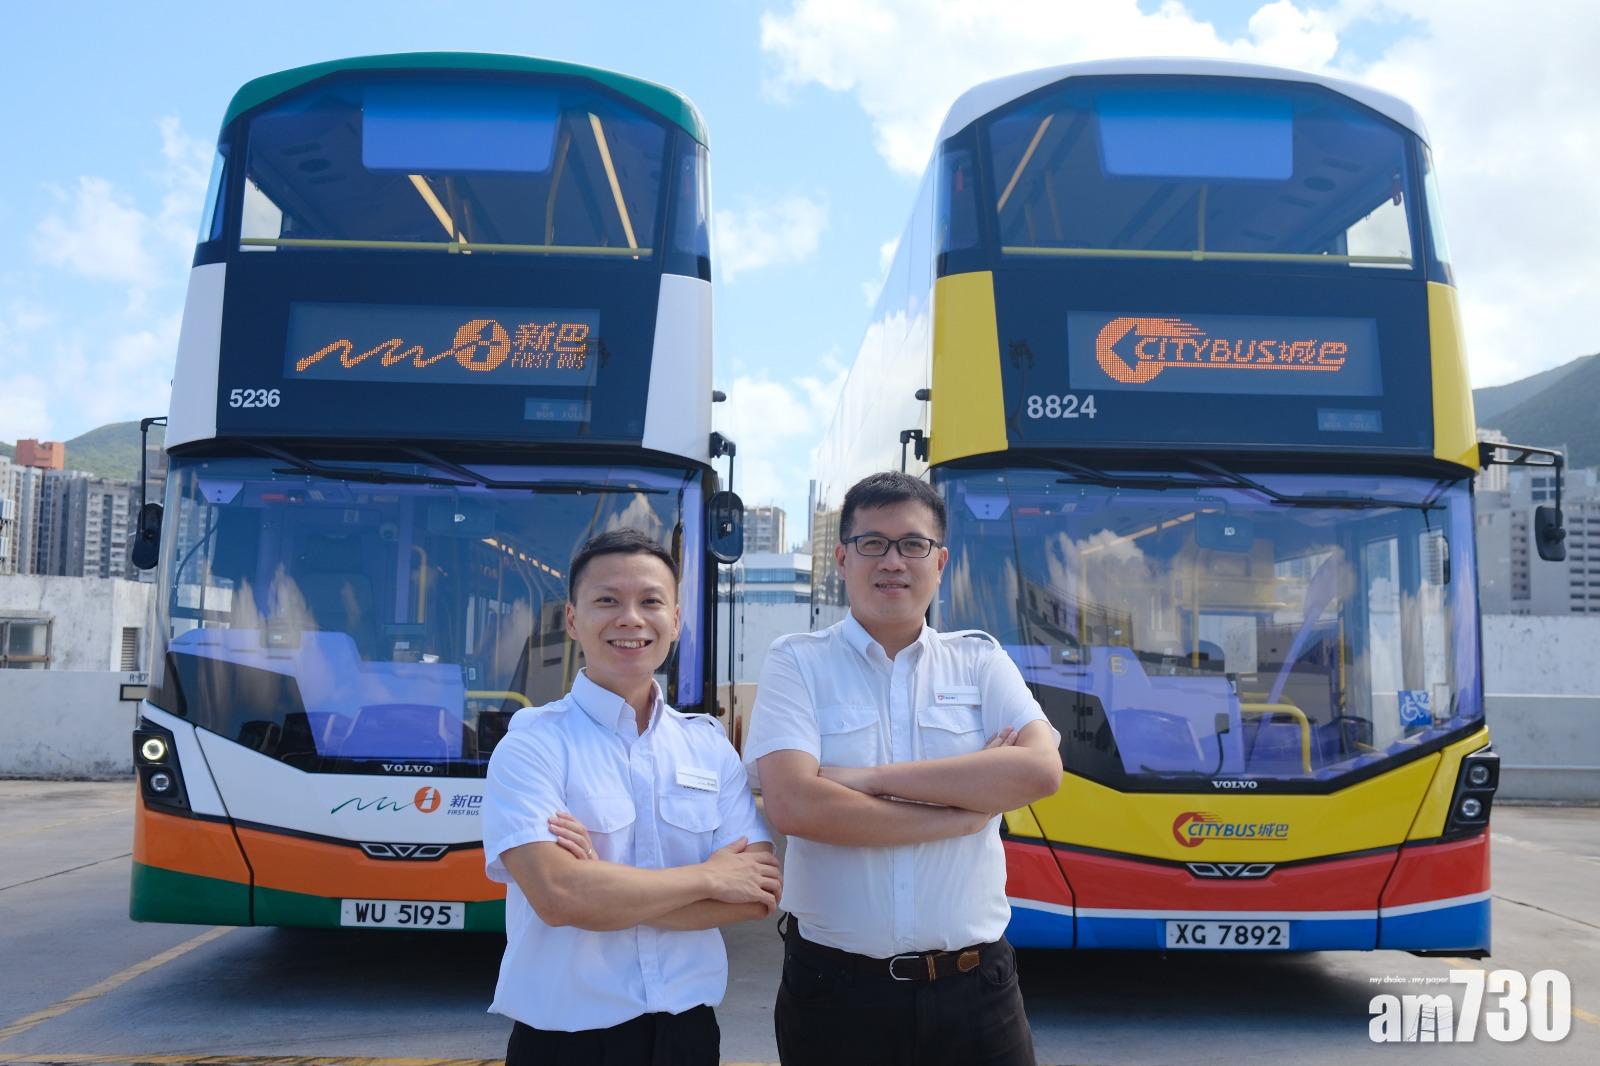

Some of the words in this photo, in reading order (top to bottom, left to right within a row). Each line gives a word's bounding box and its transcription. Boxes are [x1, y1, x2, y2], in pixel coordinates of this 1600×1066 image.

[512, 321, 590, 352] 新巴
[511, 352, 554, 369] FIRST
[556, 353, 587, 369] BUS
[1135, 337, 1277, 363] CITYBUS
[1278, 339, 1348, 365] 城巴
[229, 389, 281, 408] 5236
[1027, 395, 1098, 419] 8824
[382, 763, 434, 774] VOLVO
[1211, 780, 1258, 790] VOLVO
[450, 794, 484, 808] 新巴
[1187, 822, 1257, 838] CITYBUS
[1258, 822, 1289, 838] 城巴
[355, 903, 386, 923] WU
[397, 904, 452, 926] 5195
[1175, 923, 1206, 945] XG
[1218, 925, 1281, 946] 7892
